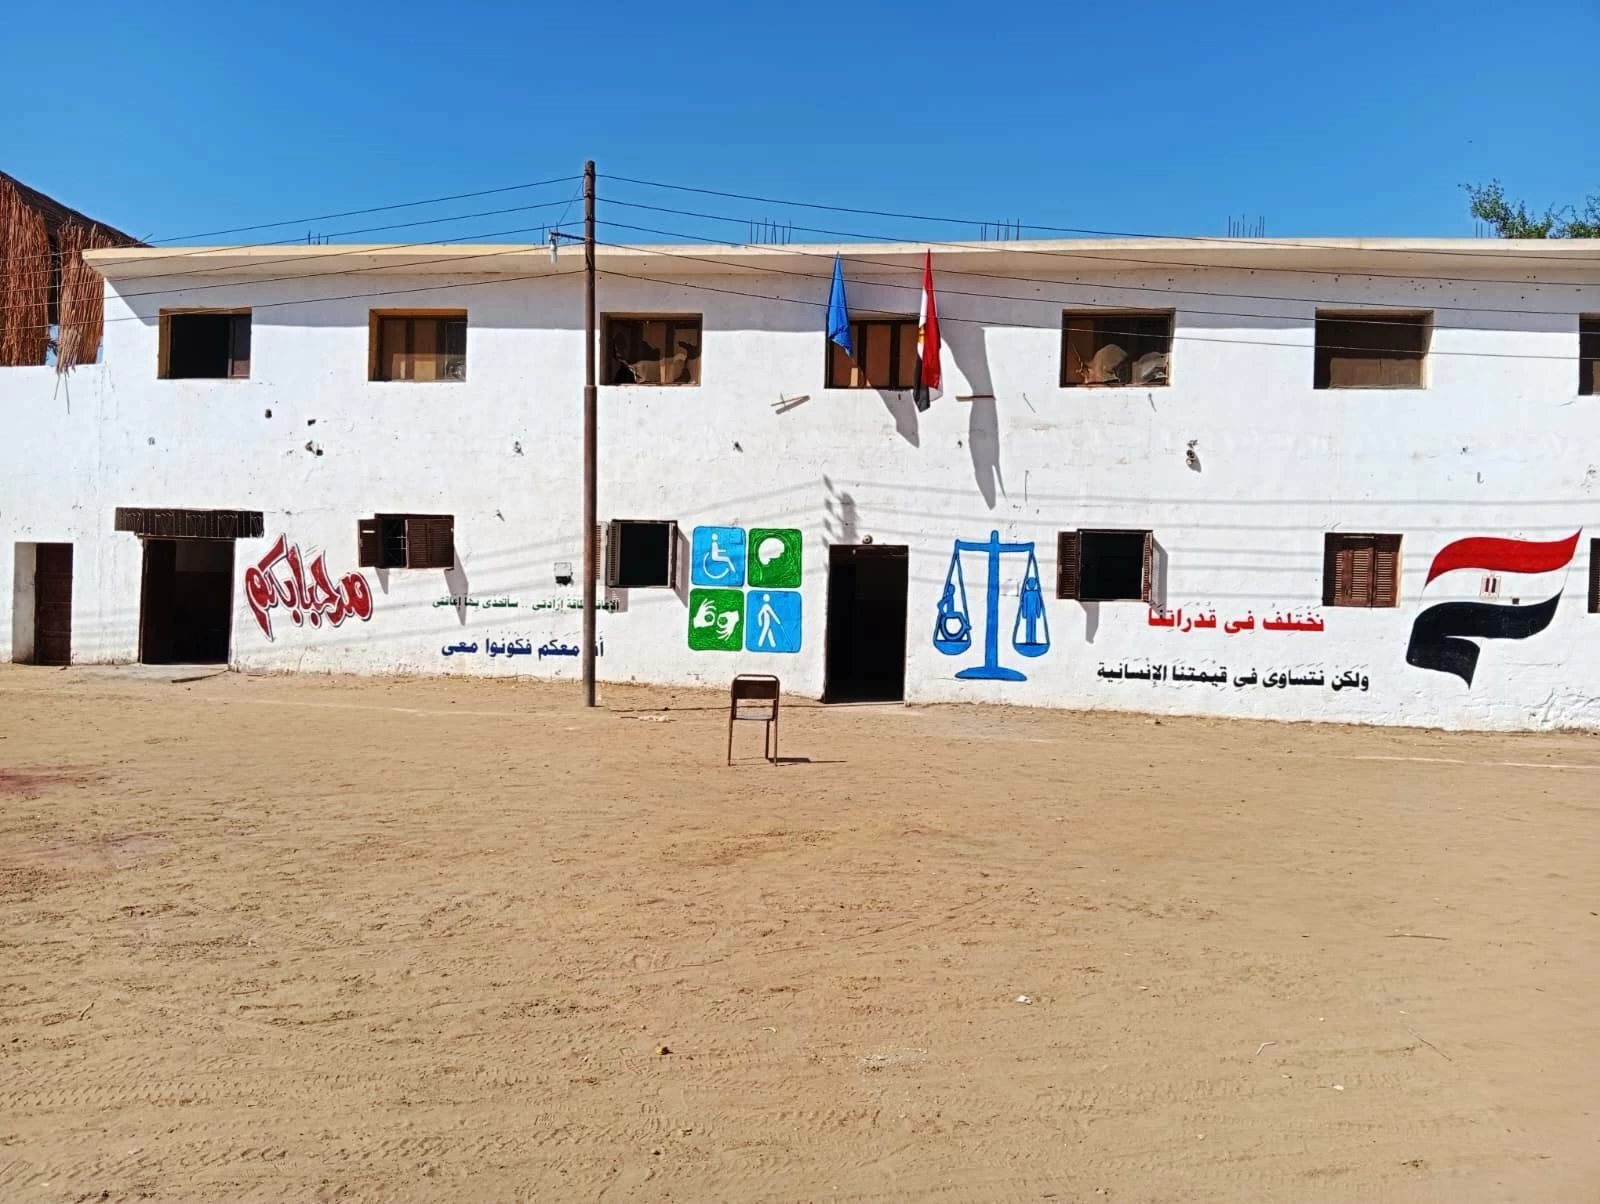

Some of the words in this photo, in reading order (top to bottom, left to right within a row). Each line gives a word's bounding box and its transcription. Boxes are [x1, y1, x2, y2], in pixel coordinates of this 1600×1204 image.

[485, 637, 532, 658] فكونوا
[537, 638, 580, 661] معكم
[1097, 661, 1167, 687] الإنسانية
[1172, 665, 1227, 687] قيمتنا
[1262, 669, 1325, 689] نتساوى
[1331, 670, 1369, 692] ولكن
